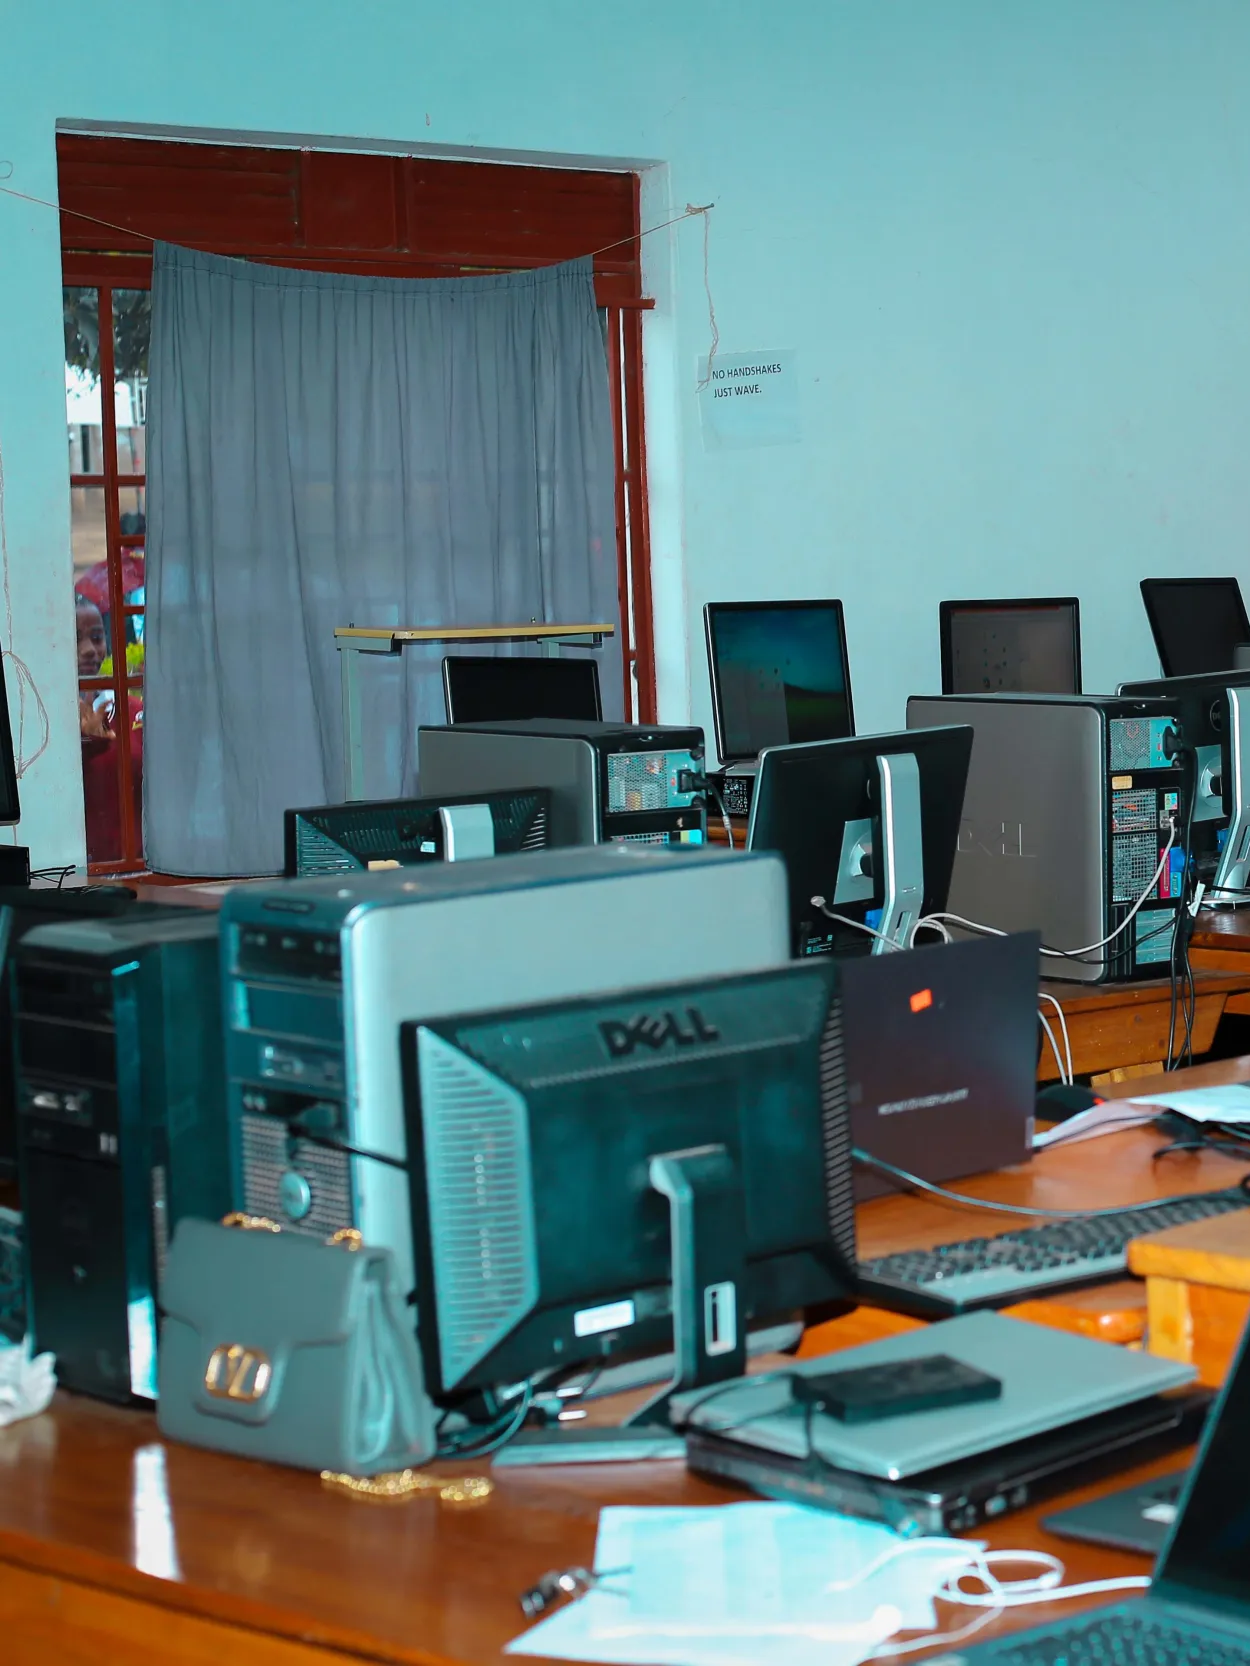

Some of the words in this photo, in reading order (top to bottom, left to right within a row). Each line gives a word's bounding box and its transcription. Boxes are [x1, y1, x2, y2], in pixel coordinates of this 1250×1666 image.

[712, 370, 725, 379] NO
[727, 364, 781, 378] HANDSHAKES
[714, 387, 732, 398] JUST
[735, 384, 762, 396] WAVE.
[598, 1006, 720, 1056] DELL
